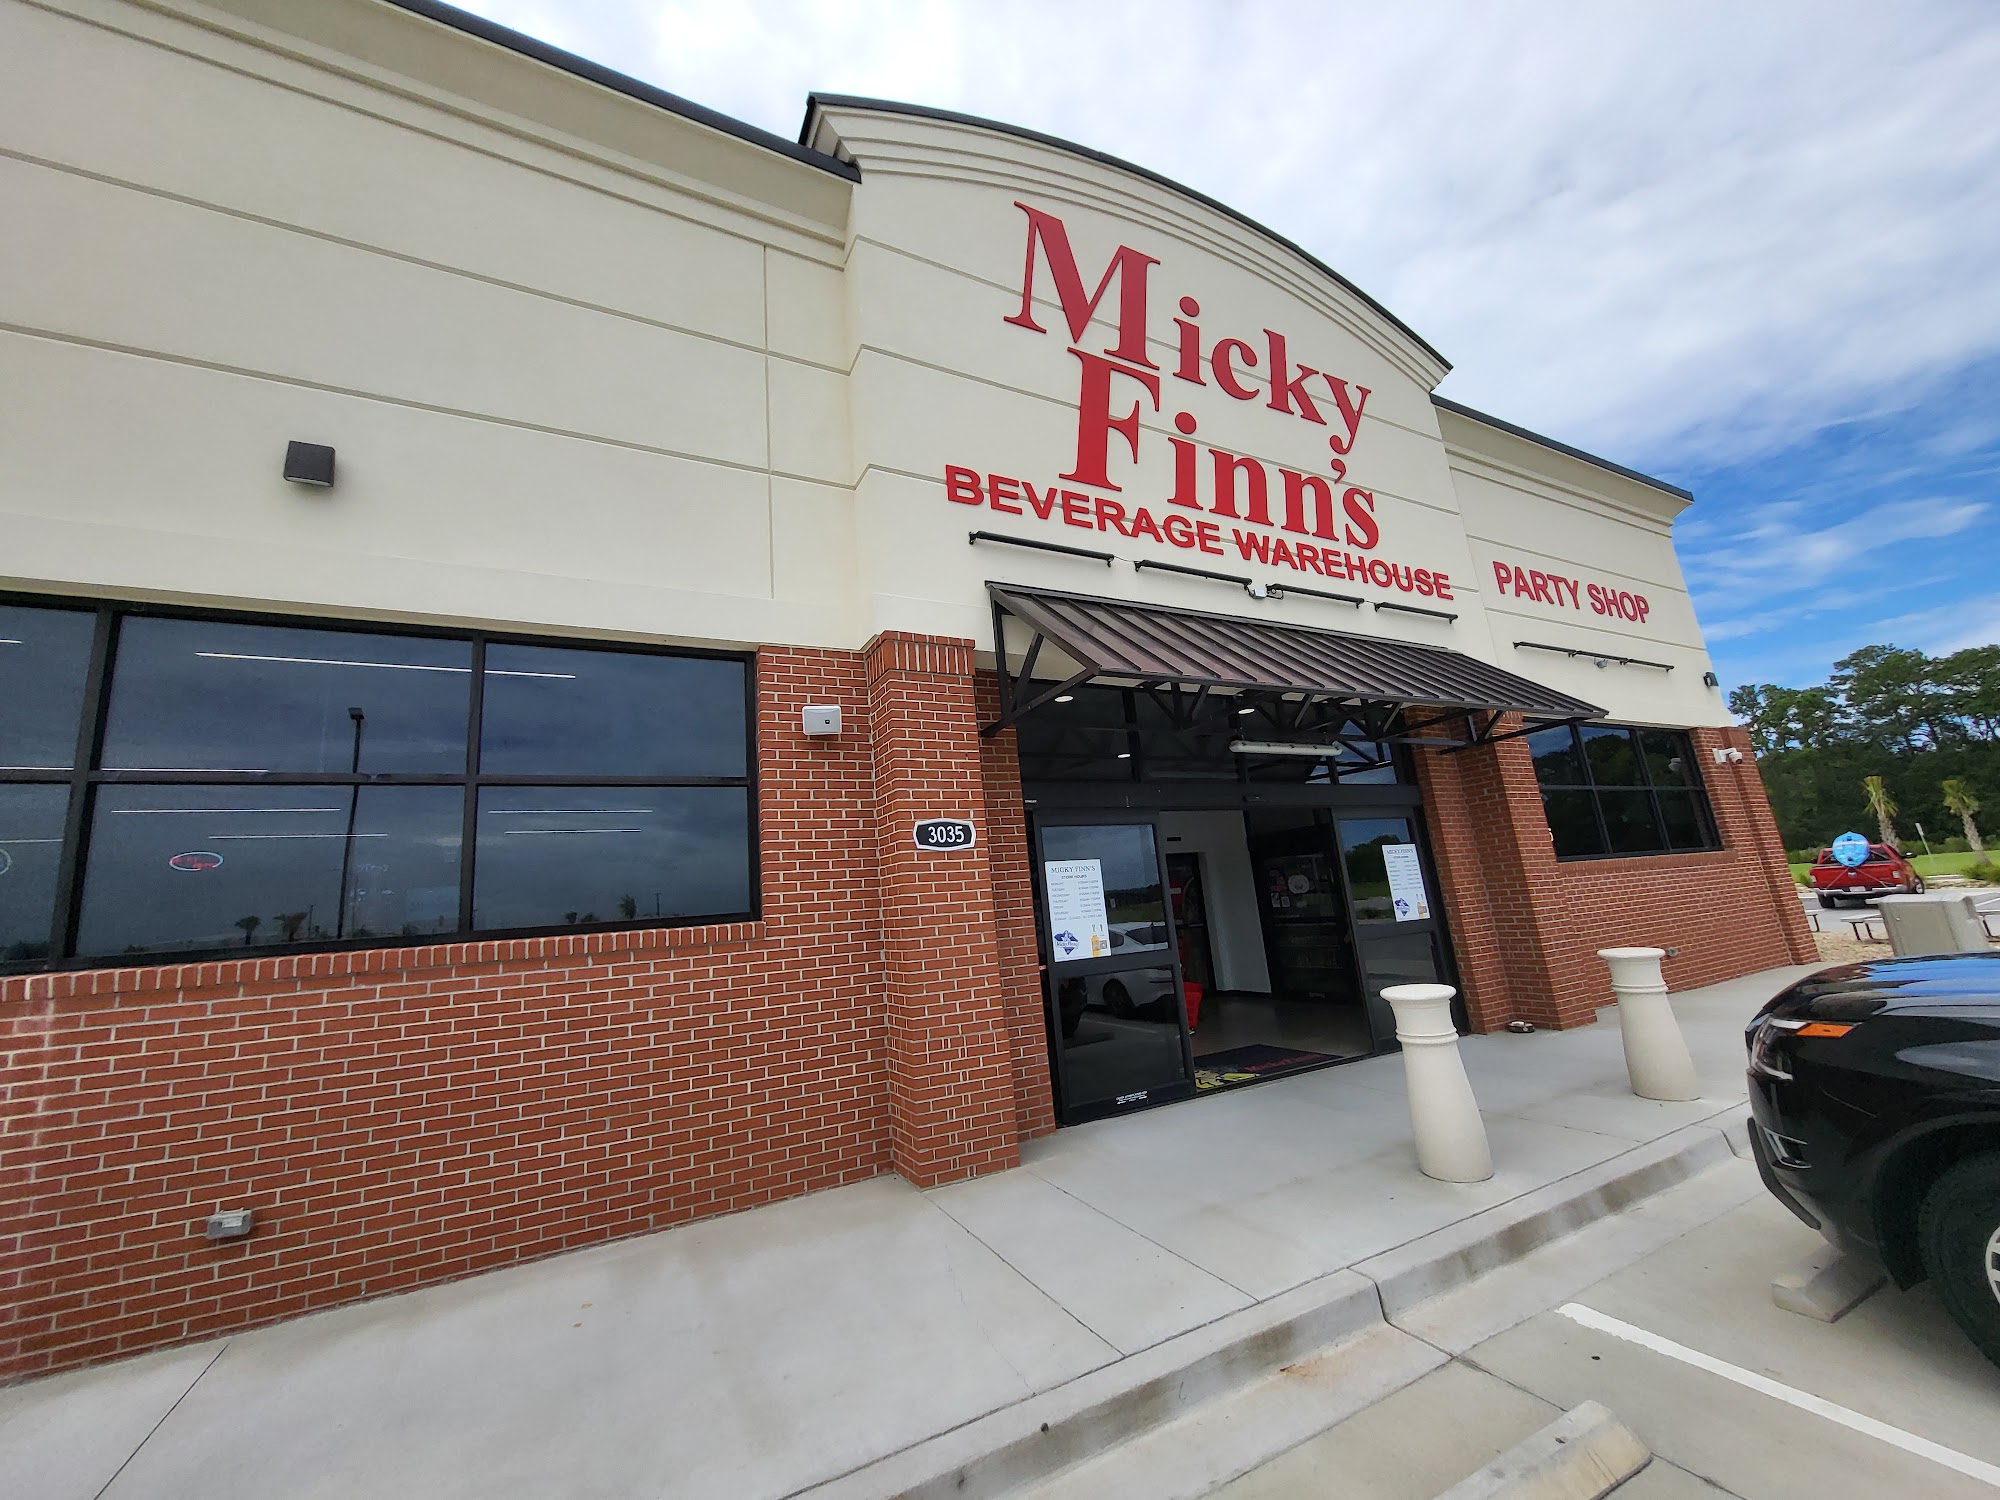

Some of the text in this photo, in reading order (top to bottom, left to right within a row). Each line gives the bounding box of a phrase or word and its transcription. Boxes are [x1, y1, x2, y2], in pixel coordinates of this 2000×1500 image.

[1003, 200, 1372, 455] Micky
[1058, 346, 1380, 550] Finn's
[944, 464, 1455, 601] BEVERAGE WAREHOUSE
[1492, 561, 1650, 625] PARTY SHOP
[927, 825, 965, 844] 3035
